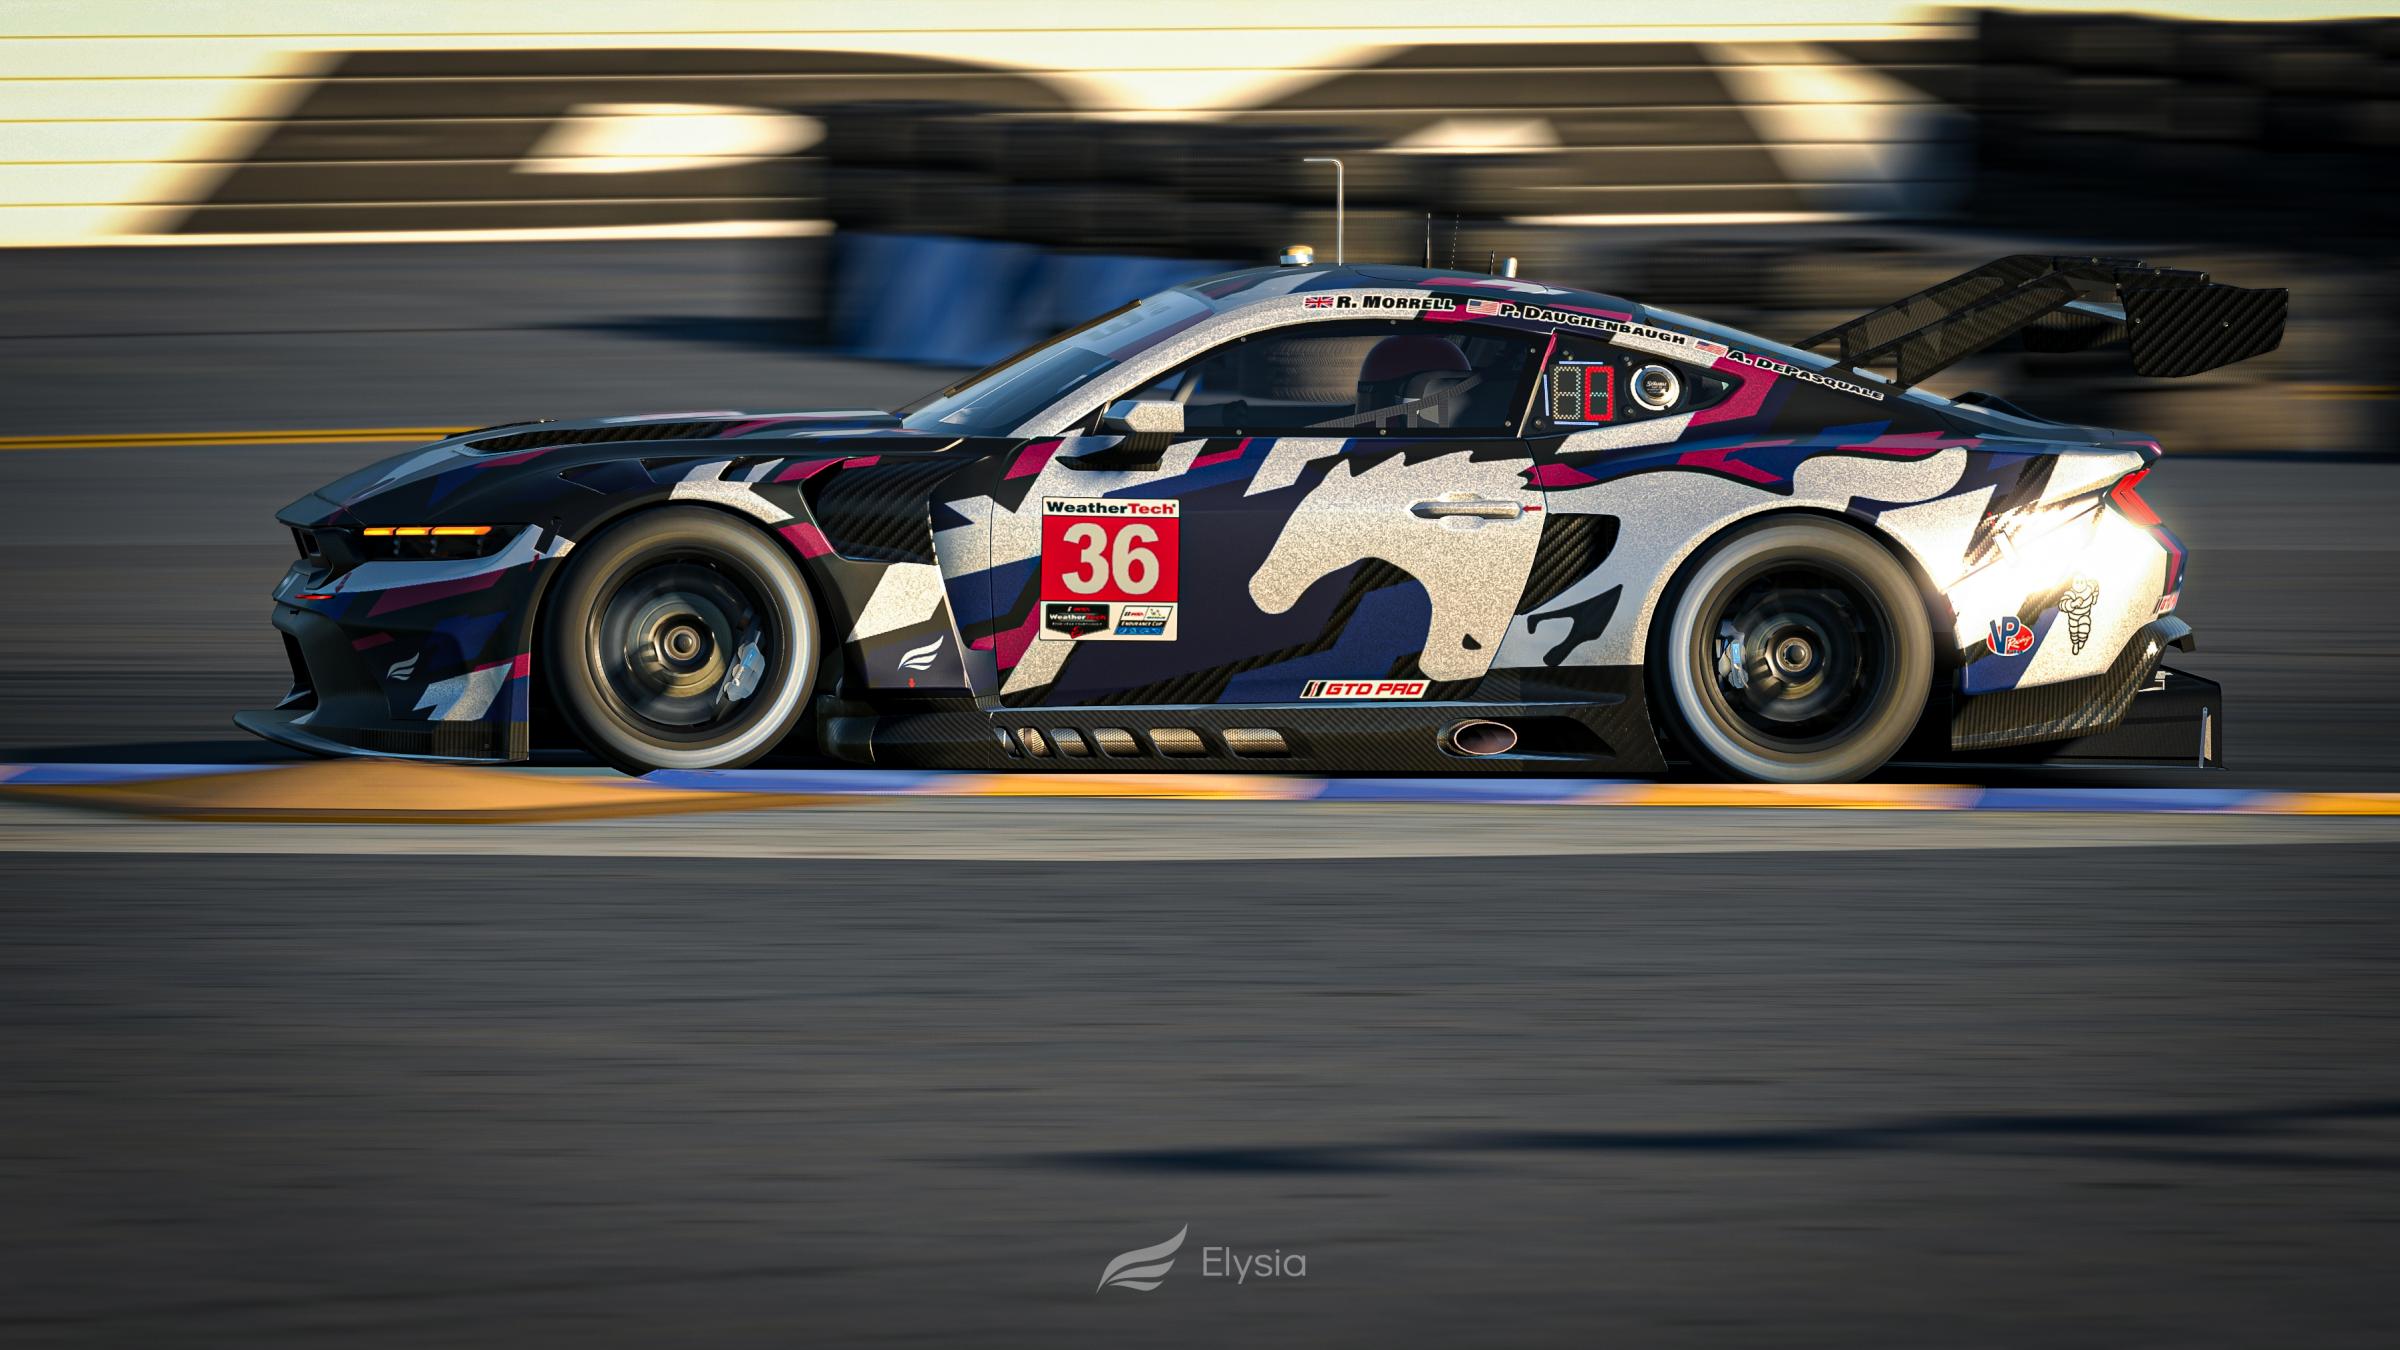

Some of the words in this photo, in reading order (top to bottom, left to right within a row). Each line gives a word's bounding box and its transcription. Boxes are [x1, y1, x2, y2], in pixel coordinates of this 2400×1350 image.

[1336, 295, 1357, 309] R.
[1362, 295, 1455, 310] MORRELL
[1500, 303, 1521, 317] P.
[1524, 306, 1686, 345] DAUGHENBAUGH
[1728, 350, 1752, 364] A.
[1046, 501, 1175, 515] WeatherTech
[1062, 522, 1160, 595] 36
[1989, 616, 2020, 654] VP
[1325, 683, 1374, 695] GTD
[1375, 683, 1425, 695] PRO
